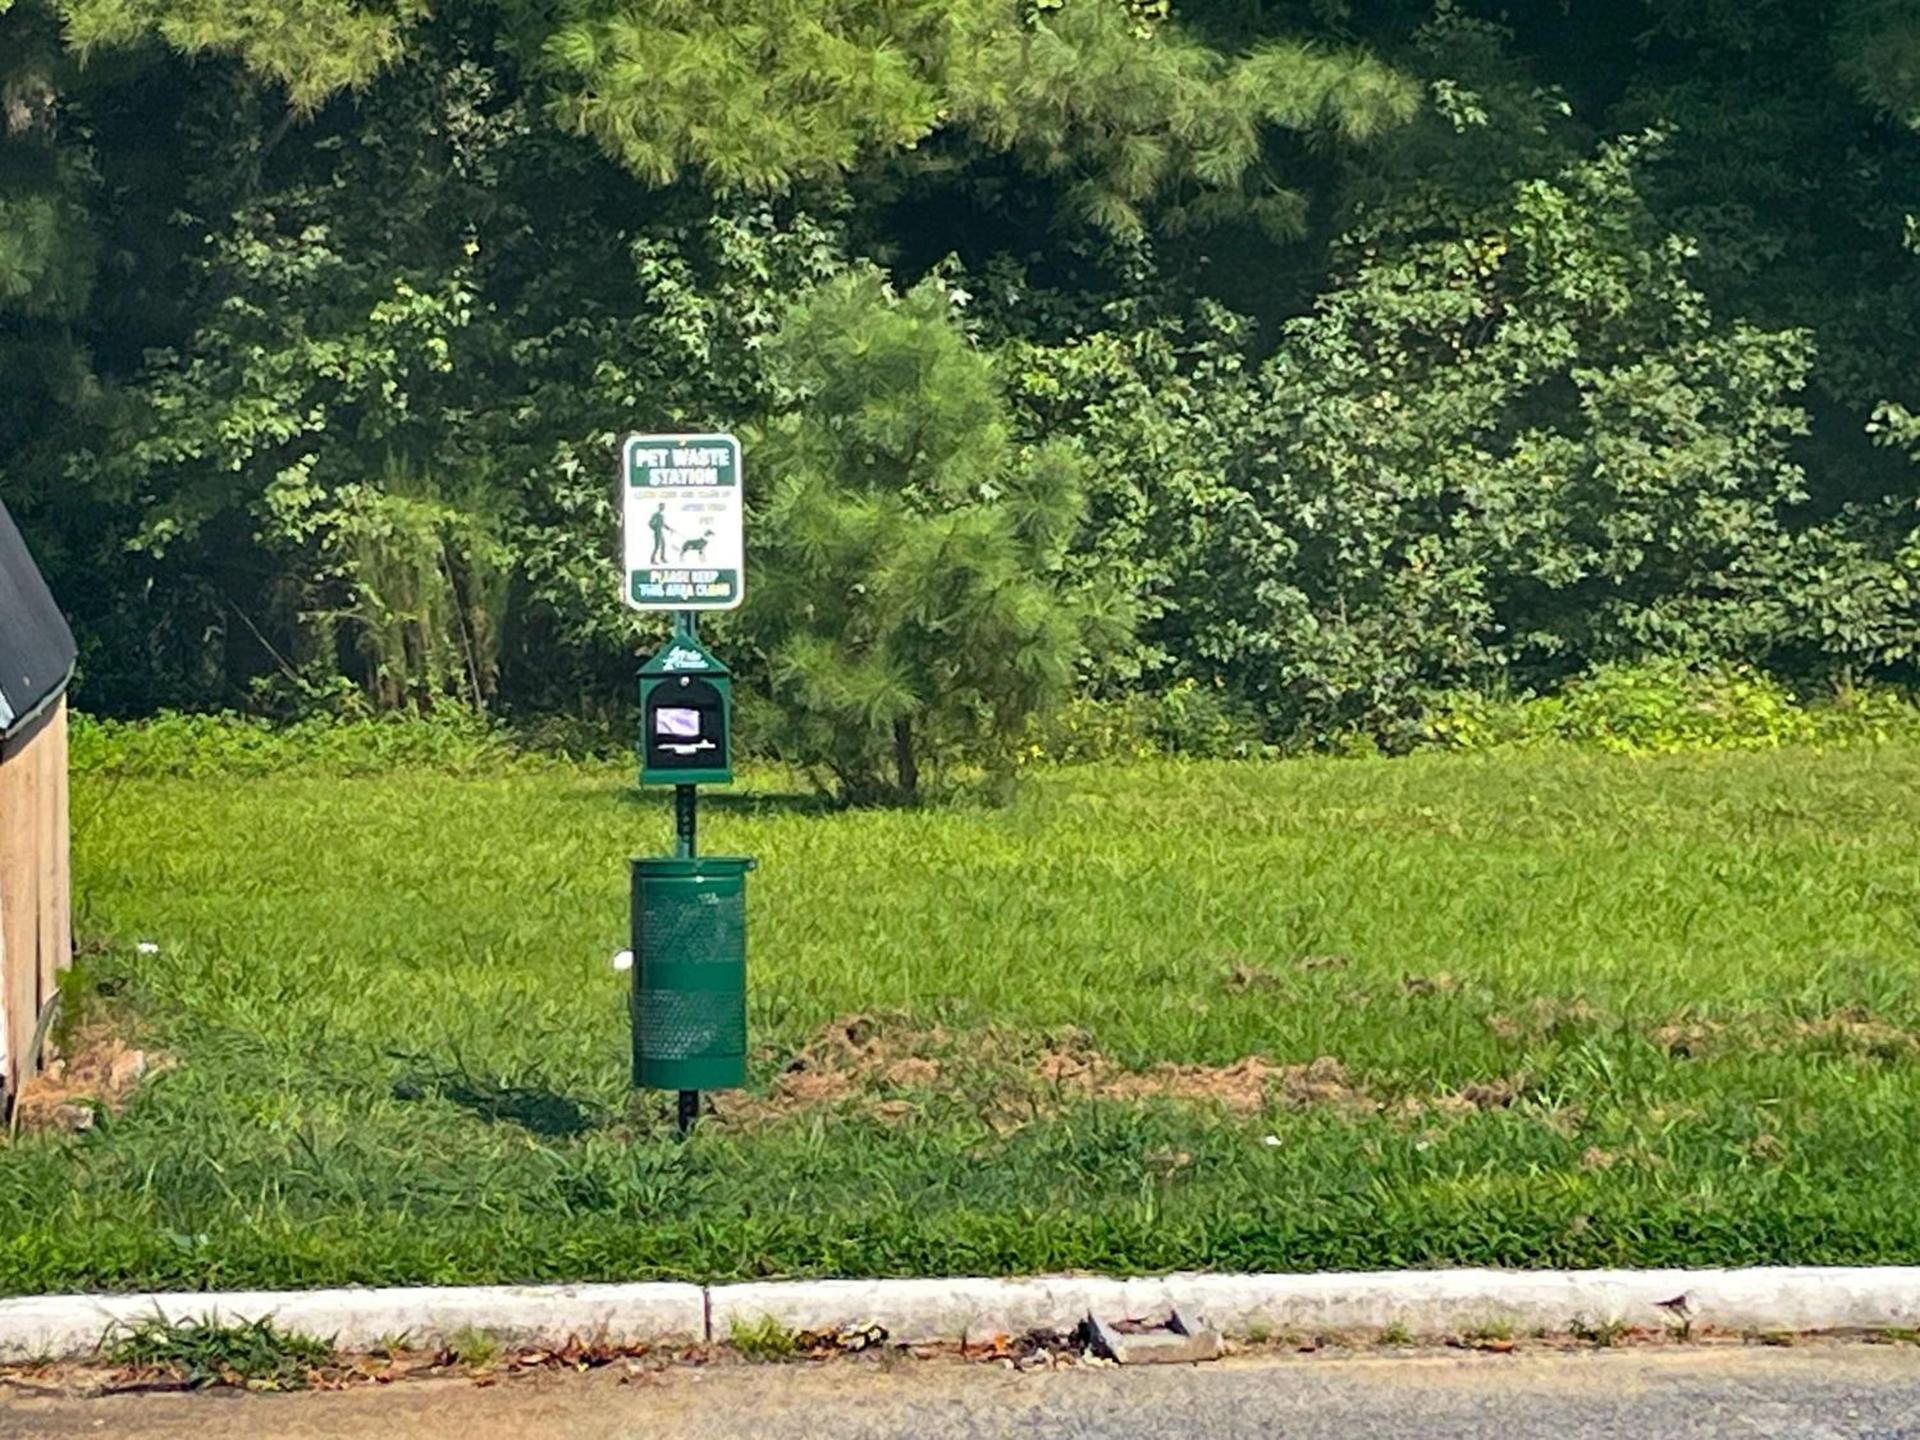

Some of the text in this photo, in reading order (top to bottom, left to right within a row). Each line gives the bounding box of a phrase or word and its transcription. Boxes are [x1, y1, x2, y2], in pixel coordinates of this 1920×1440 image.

[636, 448, 730, 468] PET WASTE
[649, 468, 718, 486] STATION
[650, 571, 690, 584] PLEASE
